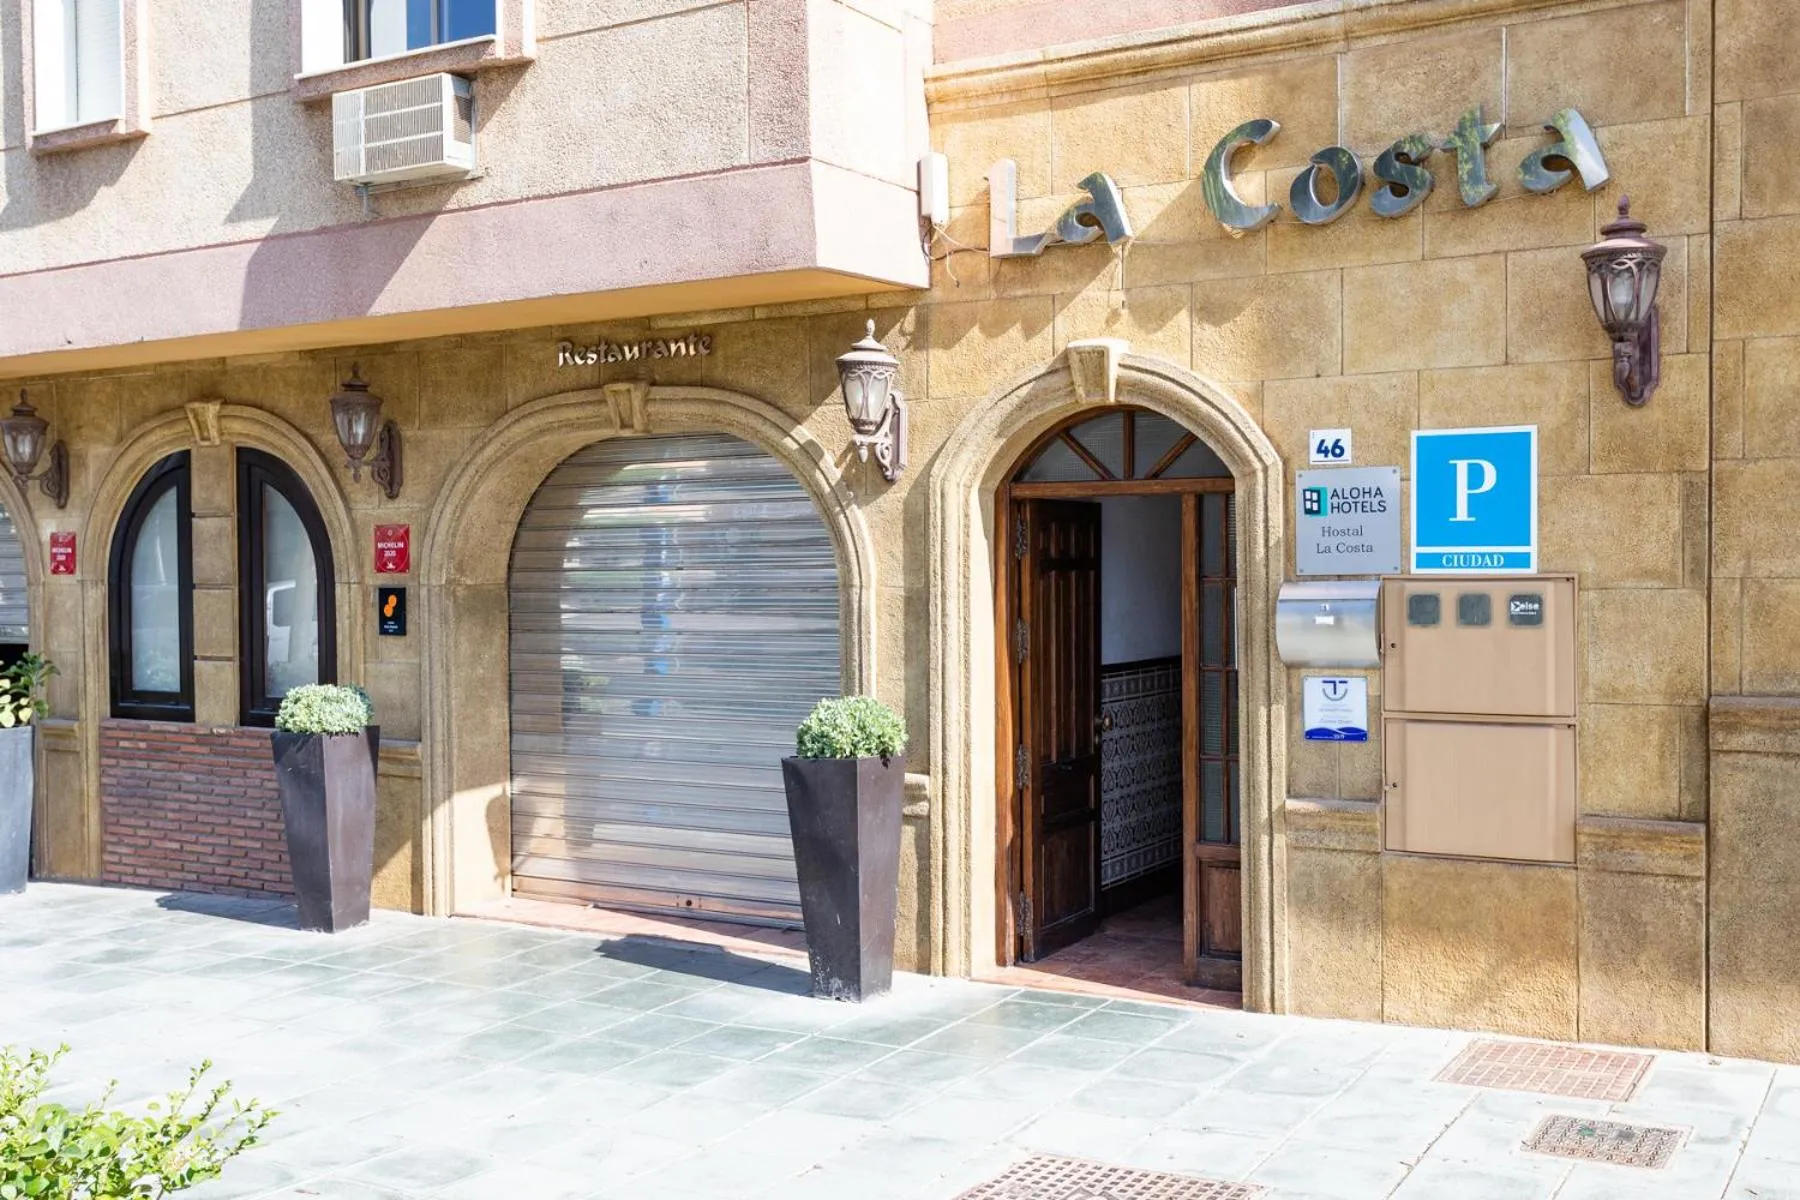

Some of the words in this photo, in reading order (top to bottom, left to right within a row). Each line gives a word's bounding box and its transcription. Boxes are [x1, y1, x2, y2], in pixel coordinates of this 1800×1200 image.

[985, 157, 1133, 258] La
[1200, 104, 1610, 231] Costa
[556, 331, 712, 367] Restaurante
[1316, 438, 1345, 458] 46
[1330, 486, 1384, 500] ALOHA
[1448, 459, 1497, 522] P
[1330, 500, 1387, 514] HOTELS
[1321, 525, 1363, 537] Hostal
[1316, 543, 1332, 554] La
[1336, 542, 1374, 553] Costa
[1441, 554, 1505, 568] CIUDAD
